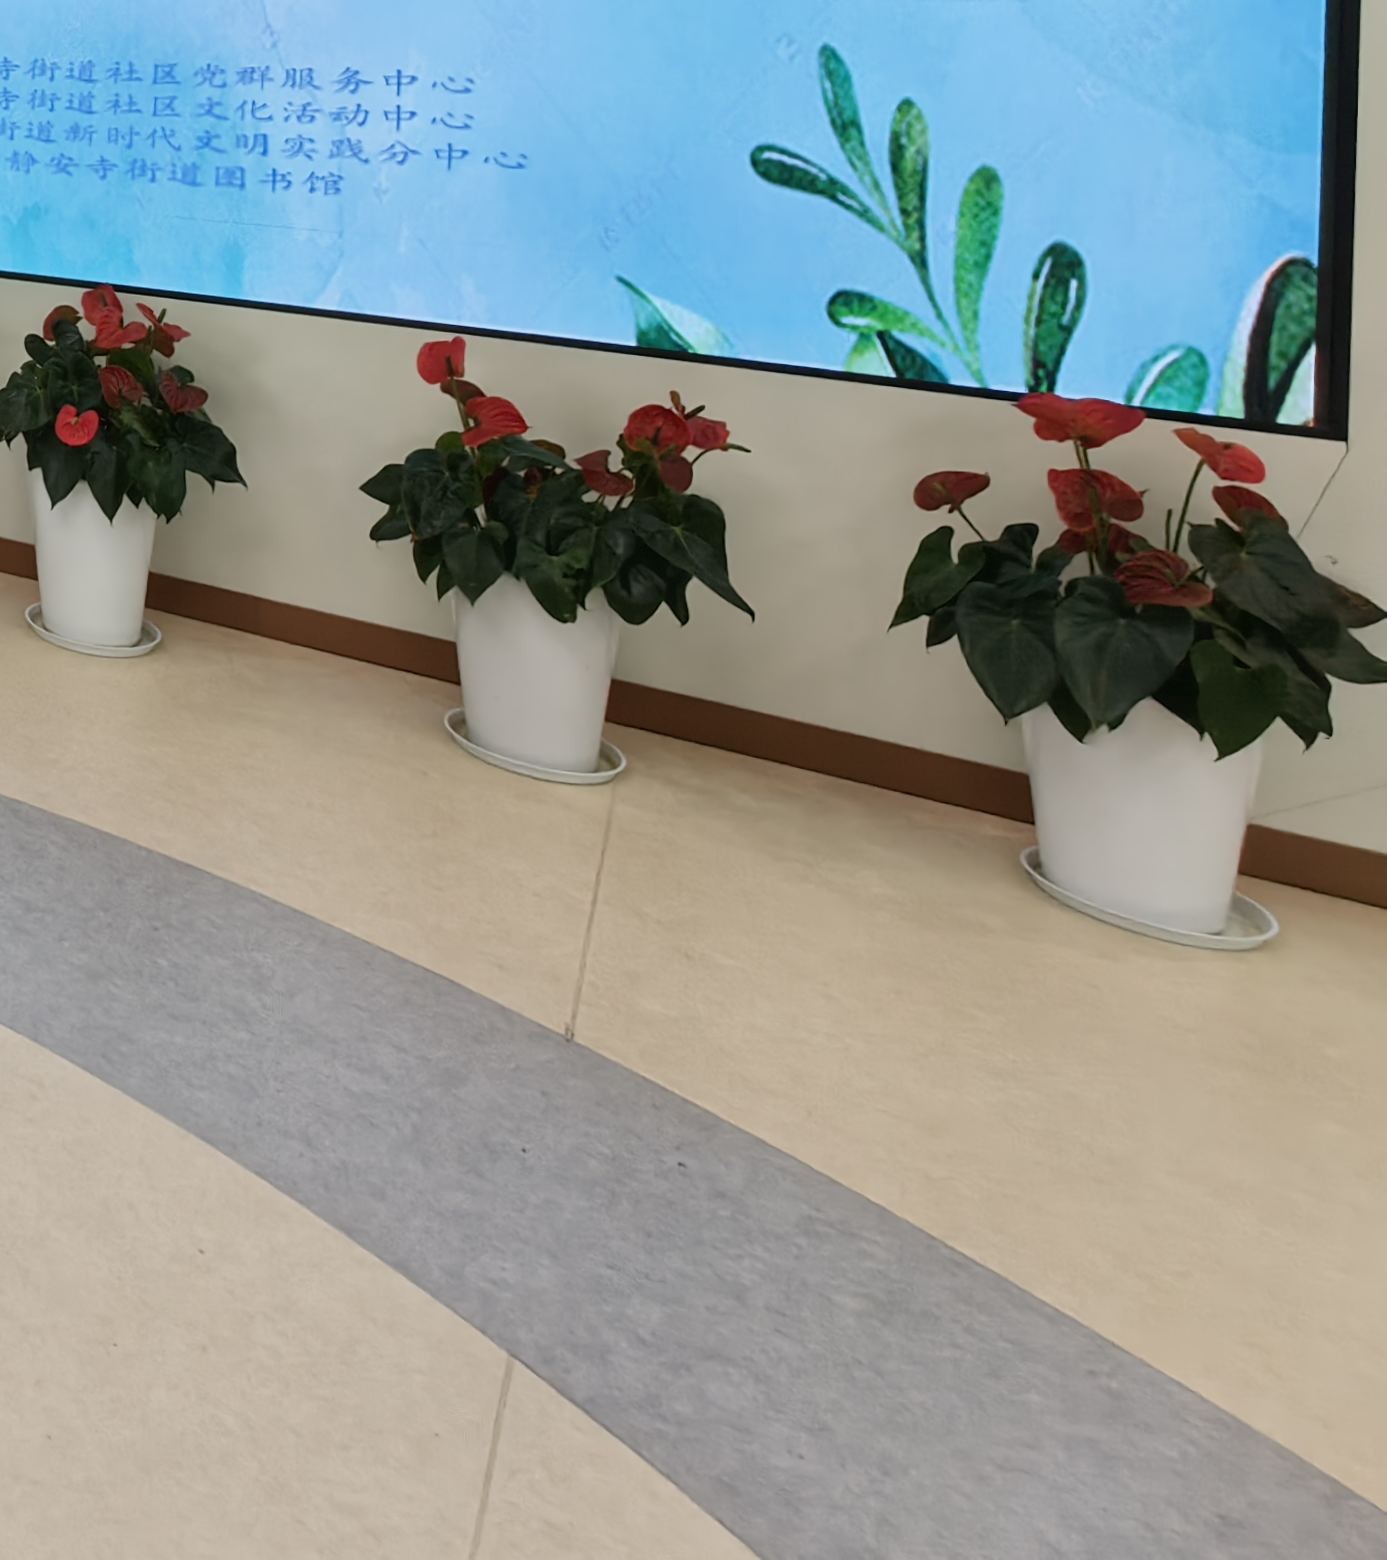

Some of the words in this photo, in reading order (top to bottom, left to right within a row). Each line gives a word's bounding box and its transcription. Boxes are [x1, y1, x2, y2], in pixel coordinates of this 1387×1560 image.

[4, 149, 345, 197] 静安寺街道图书馆
